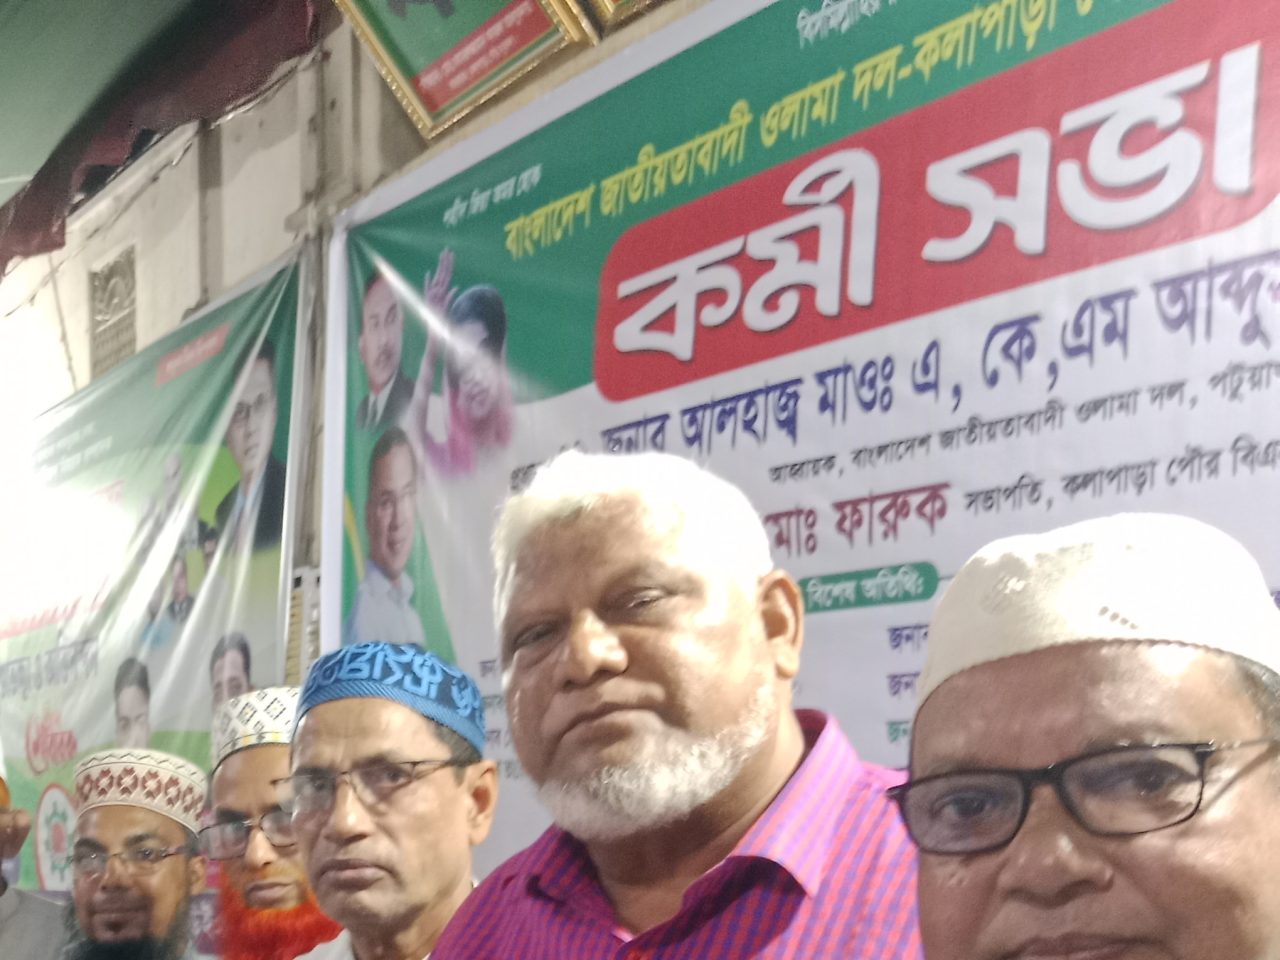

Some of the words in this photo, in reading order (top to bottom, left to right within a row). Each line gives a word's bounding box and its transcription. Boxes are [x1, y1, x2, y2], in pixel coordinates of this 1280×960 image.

[504, 183, 596, 260] বাংলাদেশ
[600, 99, 753, 217] জাতীয়তাবাদী
[759, 69, 846, 148] ওলামা
[921, 41, 1262, 262] সভা
[1150, 248, 1280, 352] আব্দু
[851, 433, 933, 469] বাংলাদেশ
[938, 396, 1068, 452] জাতীয়তাবাদী
[1073, 388, 1142, 424] ওলামা
[832, 481, 952, 549] ফারুক
[1062, 459, 1158, 501] কলাপাড়া
[1229, 432, 1280, 478] বিএ
[806, 577, 858, 609] বিশেষ
